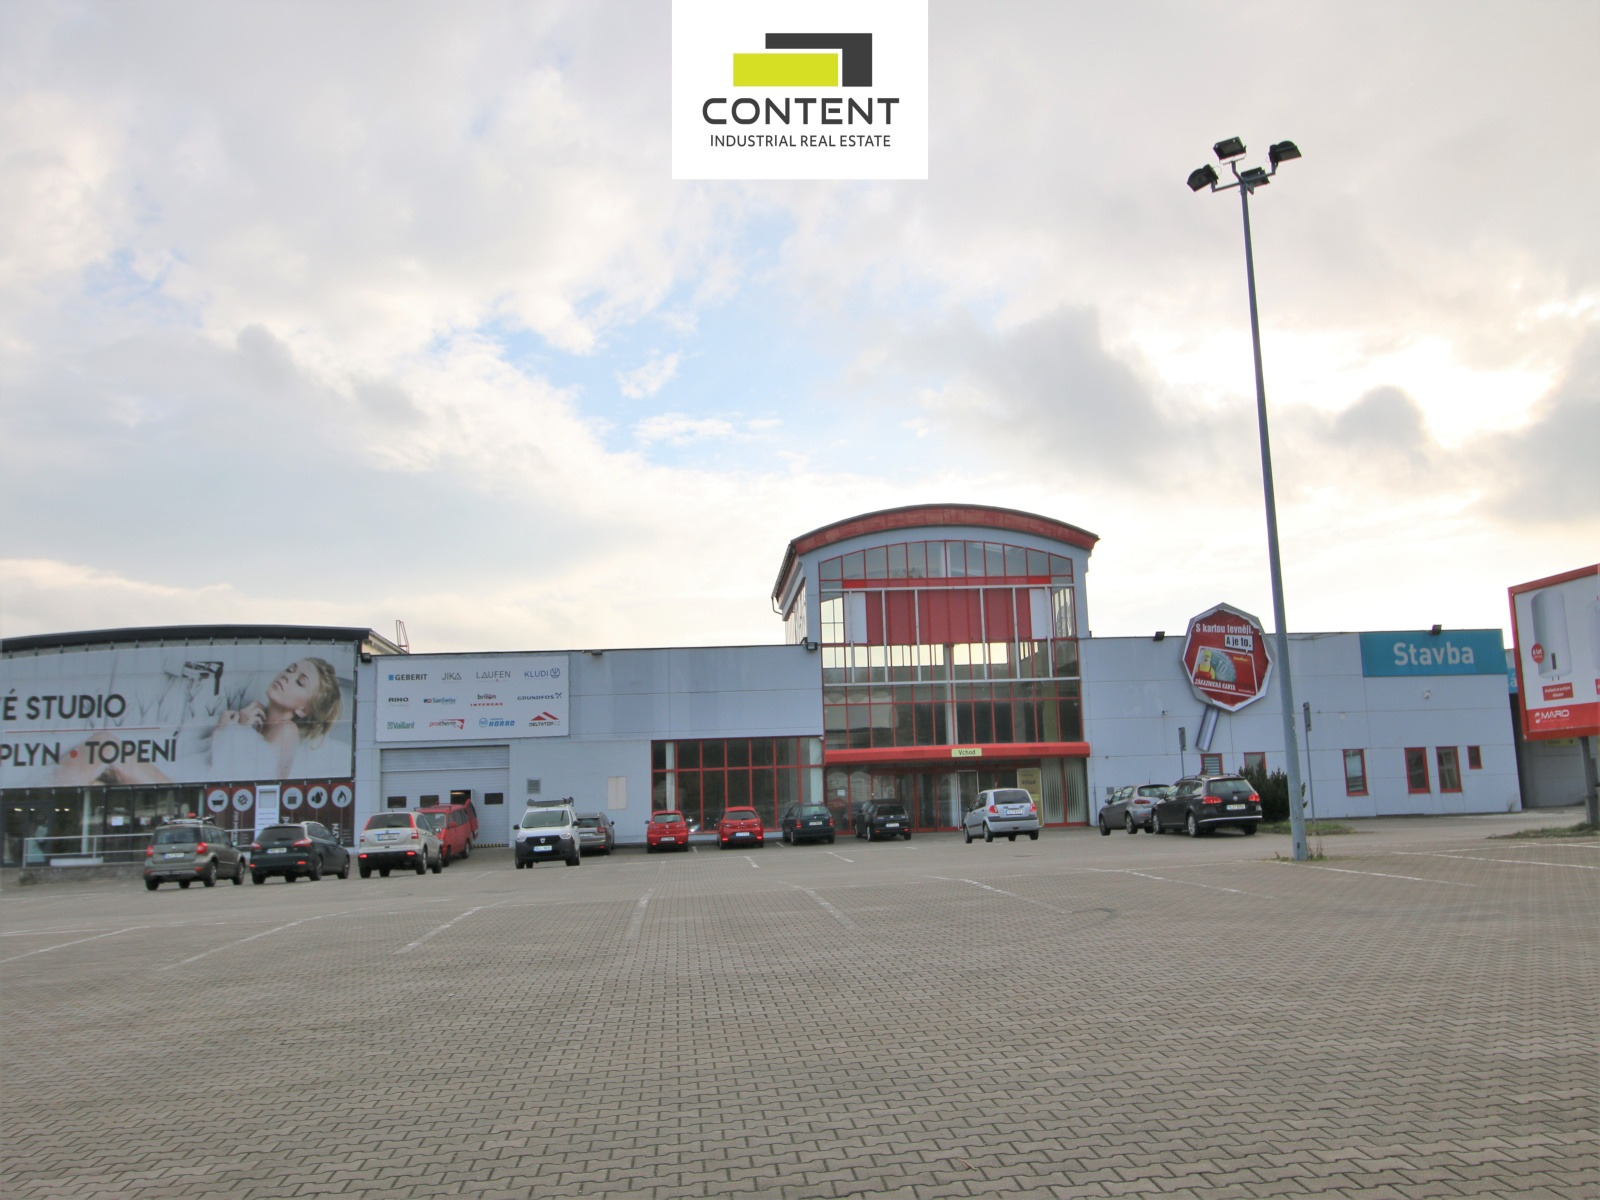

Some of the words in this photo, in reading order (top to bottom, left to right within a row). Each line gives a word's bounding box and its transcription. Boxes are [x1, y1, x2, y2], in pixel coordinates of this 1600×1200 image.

[1196, 623, 1200, 632] S
[1202, 623, 1225, 633] kartou
[1226, 636, 1231, 645] A
[1232, 637, 1239, 647] je
[1393, 641, 1474, 666] Stavba
[395, 673, 428, 681] GEBERIT
[441, 672, 462, 681] JIKA
[476, 670, 511, 679] LAUFEN
[524, 669, 549, 678] KLUDI
[0, 687, 18, 720] É
[26, 693, 127, 720] STUDIO
[1541, 709, 1570, 719] MARO
[0, 742, 60, 767] PLYN
[85, 731, 180, 765] TOPENÍ
